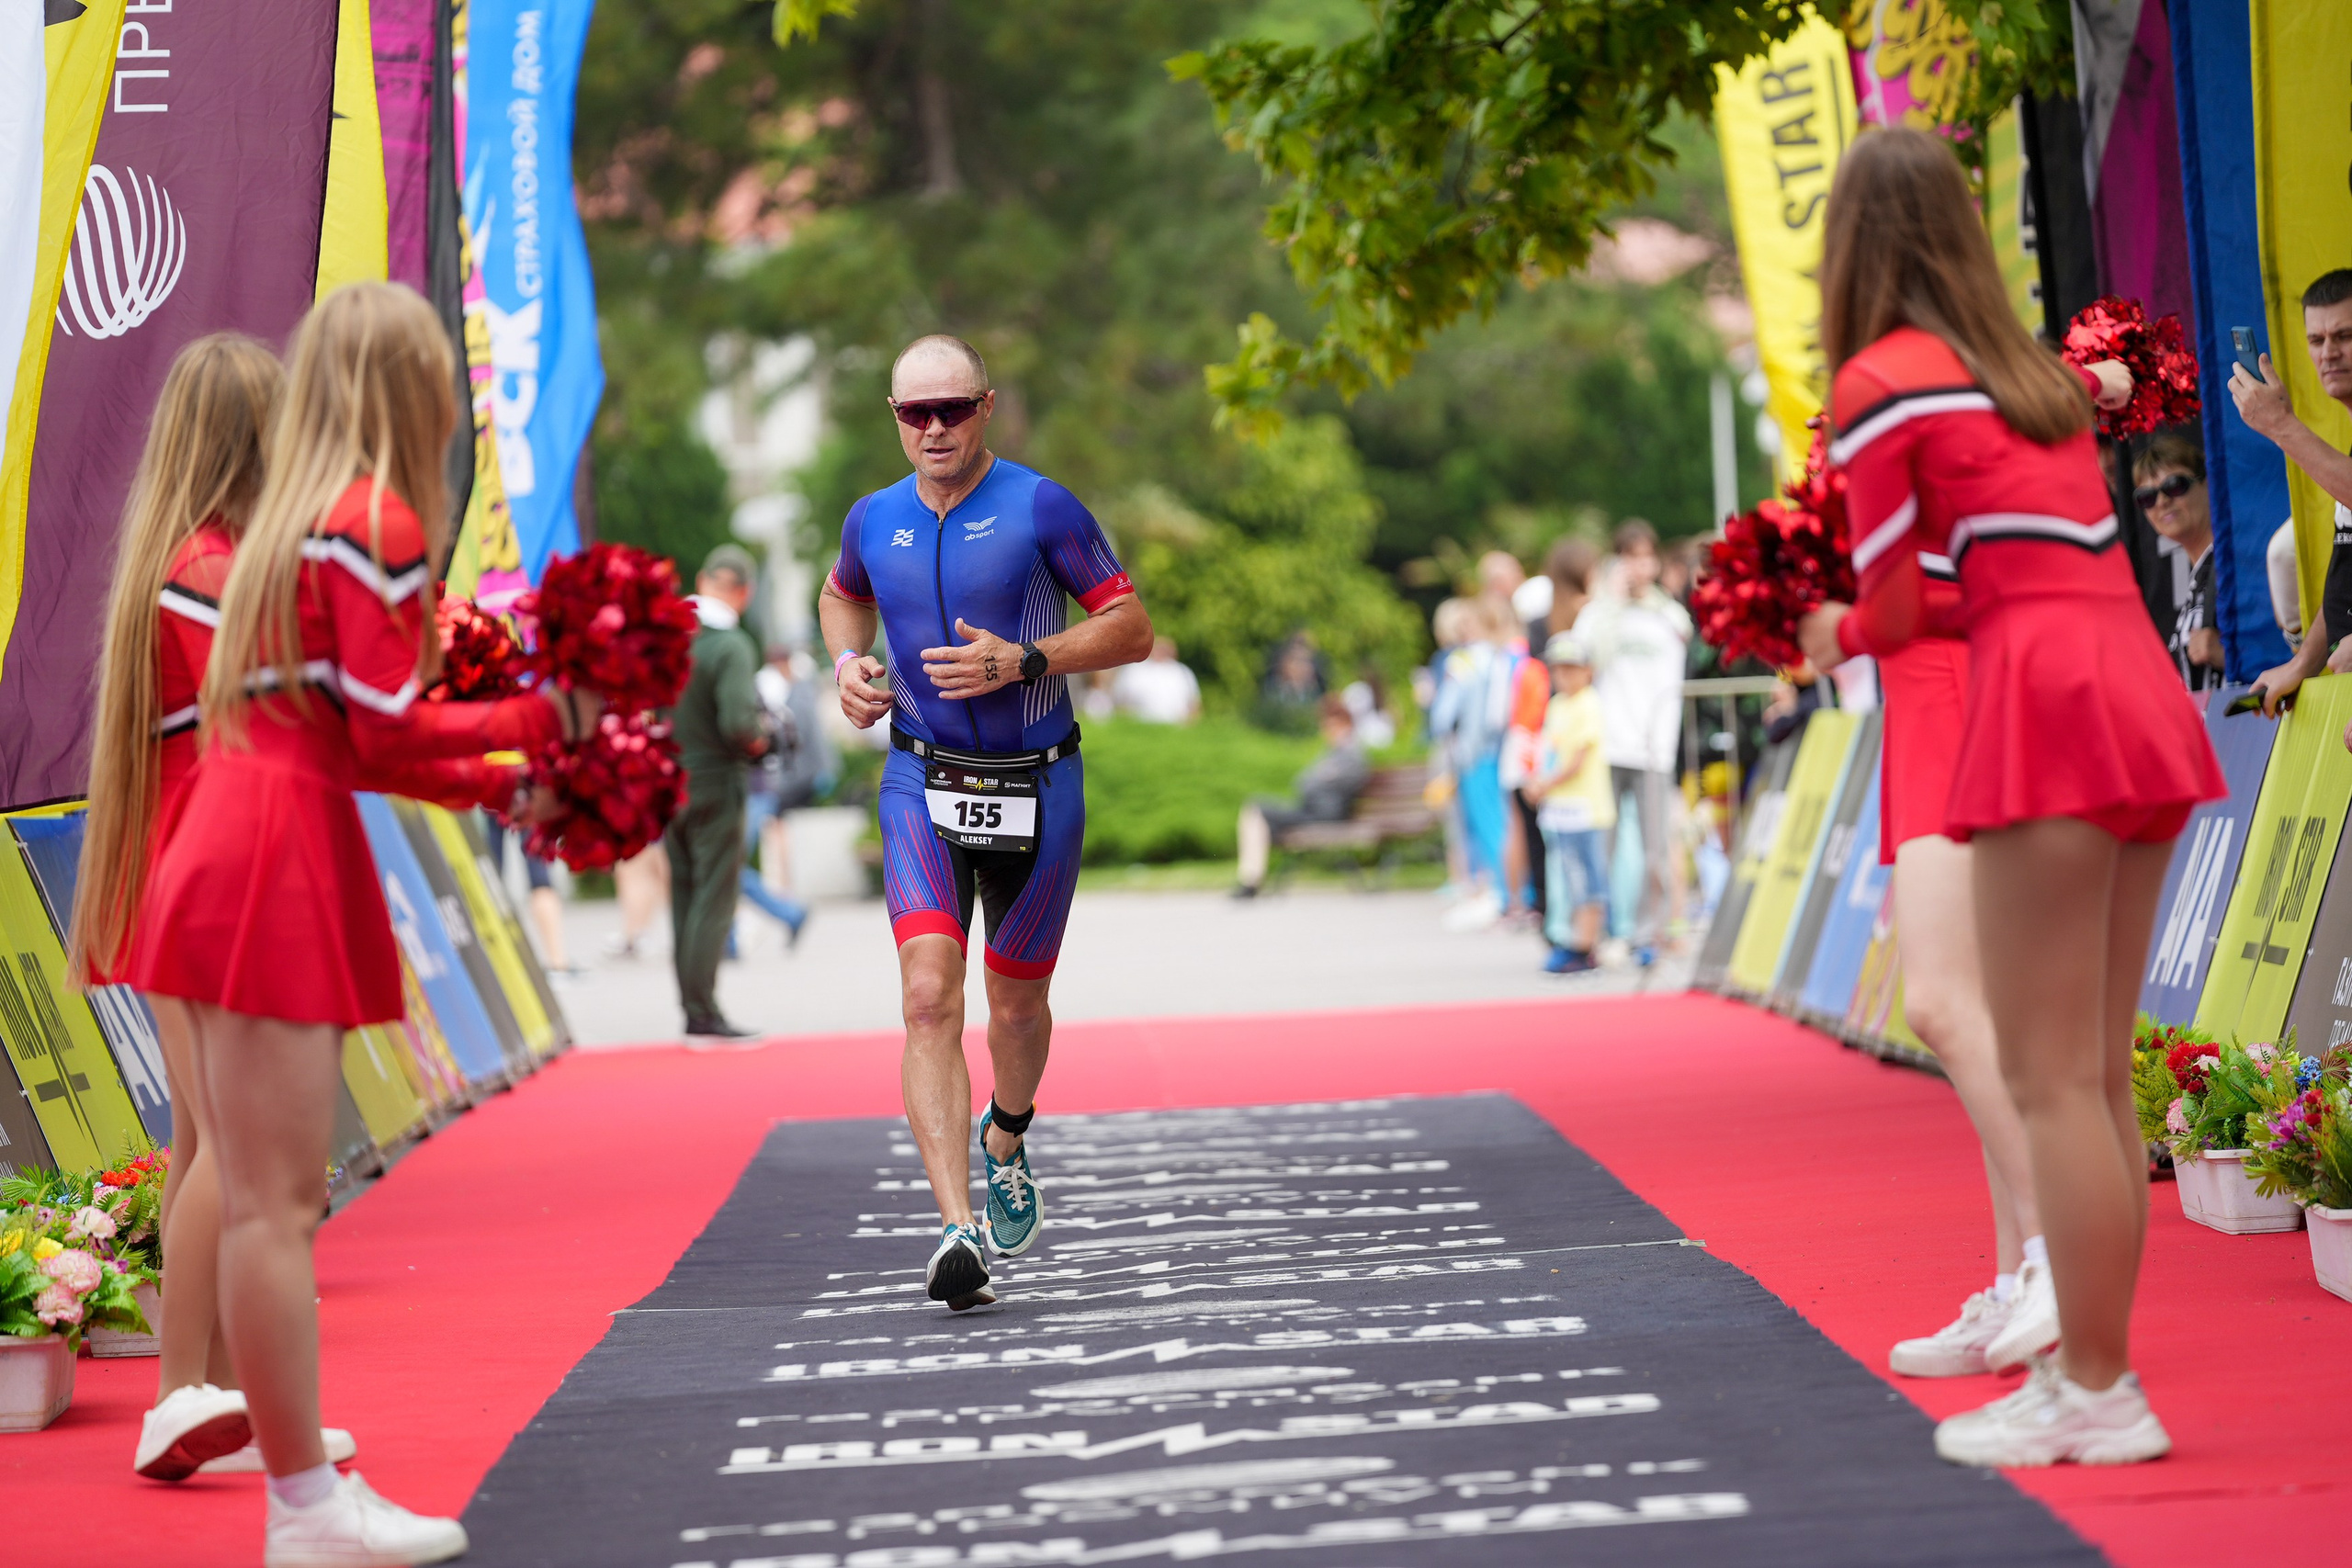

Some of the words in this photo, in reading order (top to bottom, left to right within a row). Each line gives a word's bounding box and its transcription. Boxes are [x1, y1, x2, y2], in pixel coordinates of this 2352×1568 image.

[511, 9, 543, 95] ДОМ
[1759, 61, 1828, 230] STAR
[507, 98, 543, 299] СТРАХОВОЙ
[486, 299, 543, 497] ВСК
[984, 655, 998, 681] 155
[963, 775, 978, 784] IRON
[983, 778, 999, 786] STAR
[955, 800, 1002, 829] 155
[960, 834, 993, 845] ALEKSEY
[2278, 816, 2326, 922] STAR
[771, 1344, 1085, 1377] IRON
[1253, 1316, 1588, 1344] STAR
[729, 1430, 1088, 1464] IRON
[1280, 1393, 1660, 1433] STAR
[1307, 1492, 1750, 1545] STAR
